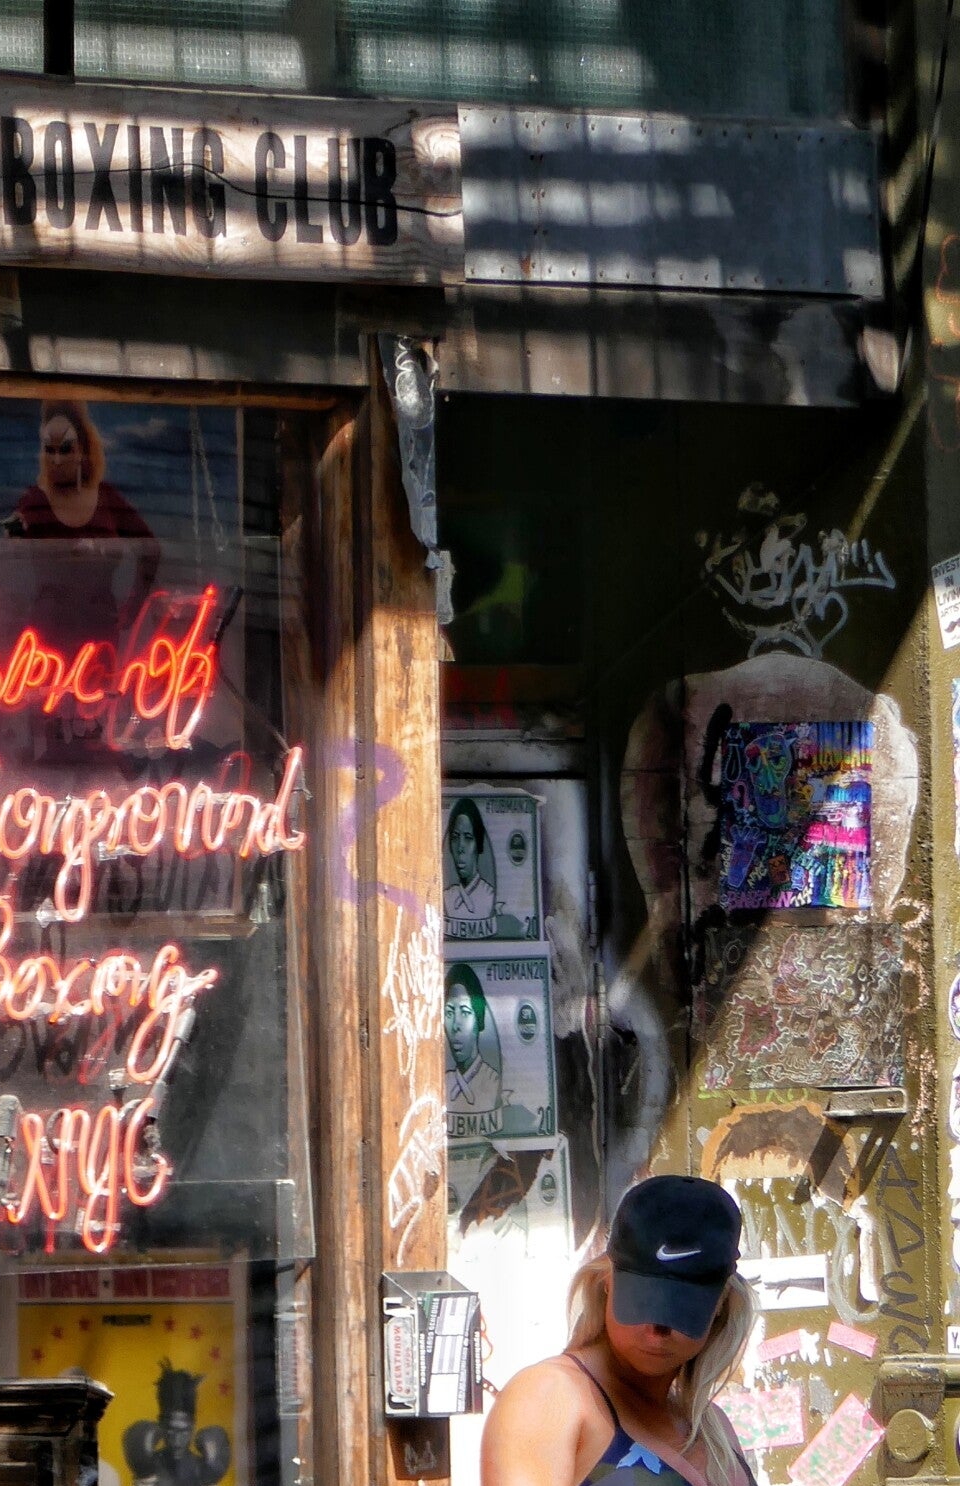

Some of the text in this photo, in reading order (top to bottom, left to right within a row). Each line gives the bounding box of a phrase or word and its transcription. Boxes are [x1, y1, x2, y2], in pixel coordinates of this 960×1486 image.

[0, 116, 228, 238] BOXING
[255, 132, 398, 246] CLUB
[537, 1106, 553, 1138] 20
